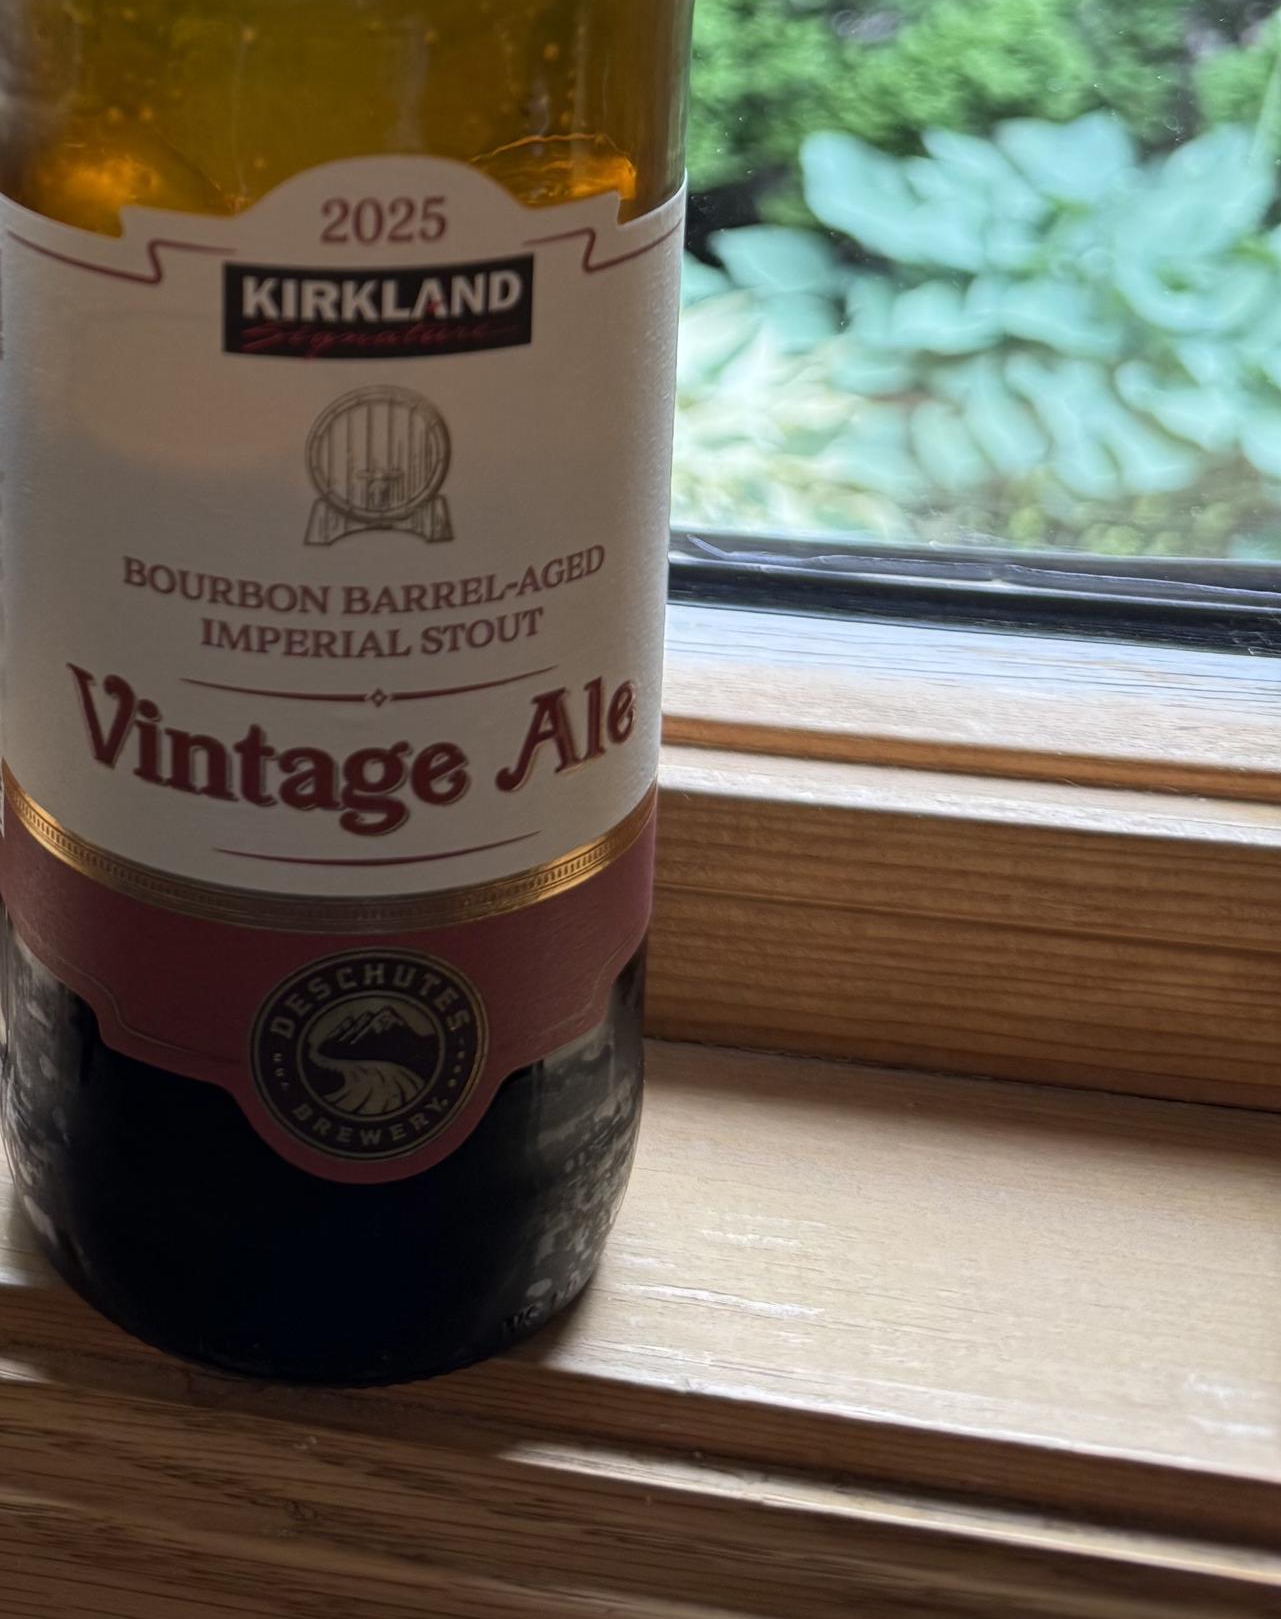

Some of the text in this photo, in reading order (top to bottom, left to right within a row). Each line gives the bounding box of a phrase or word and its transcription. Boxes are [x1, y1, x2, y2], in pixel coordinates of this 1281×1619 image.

[321, 196, 448, 245] 2025
[241, 271, 521, 322] KIRKLAND
[241, 321, 520, 358] Signature
[123, 544, 607, 616] BOURBON BARREL-AGED
[200, 608, 545, 660] IMPERIAL STOUT
[66, 660, 637, 837] Vintage Ale
[269, 961, 471, 1040] DESCHUTES
[291, 1096, 446, 1147] BREWERY
